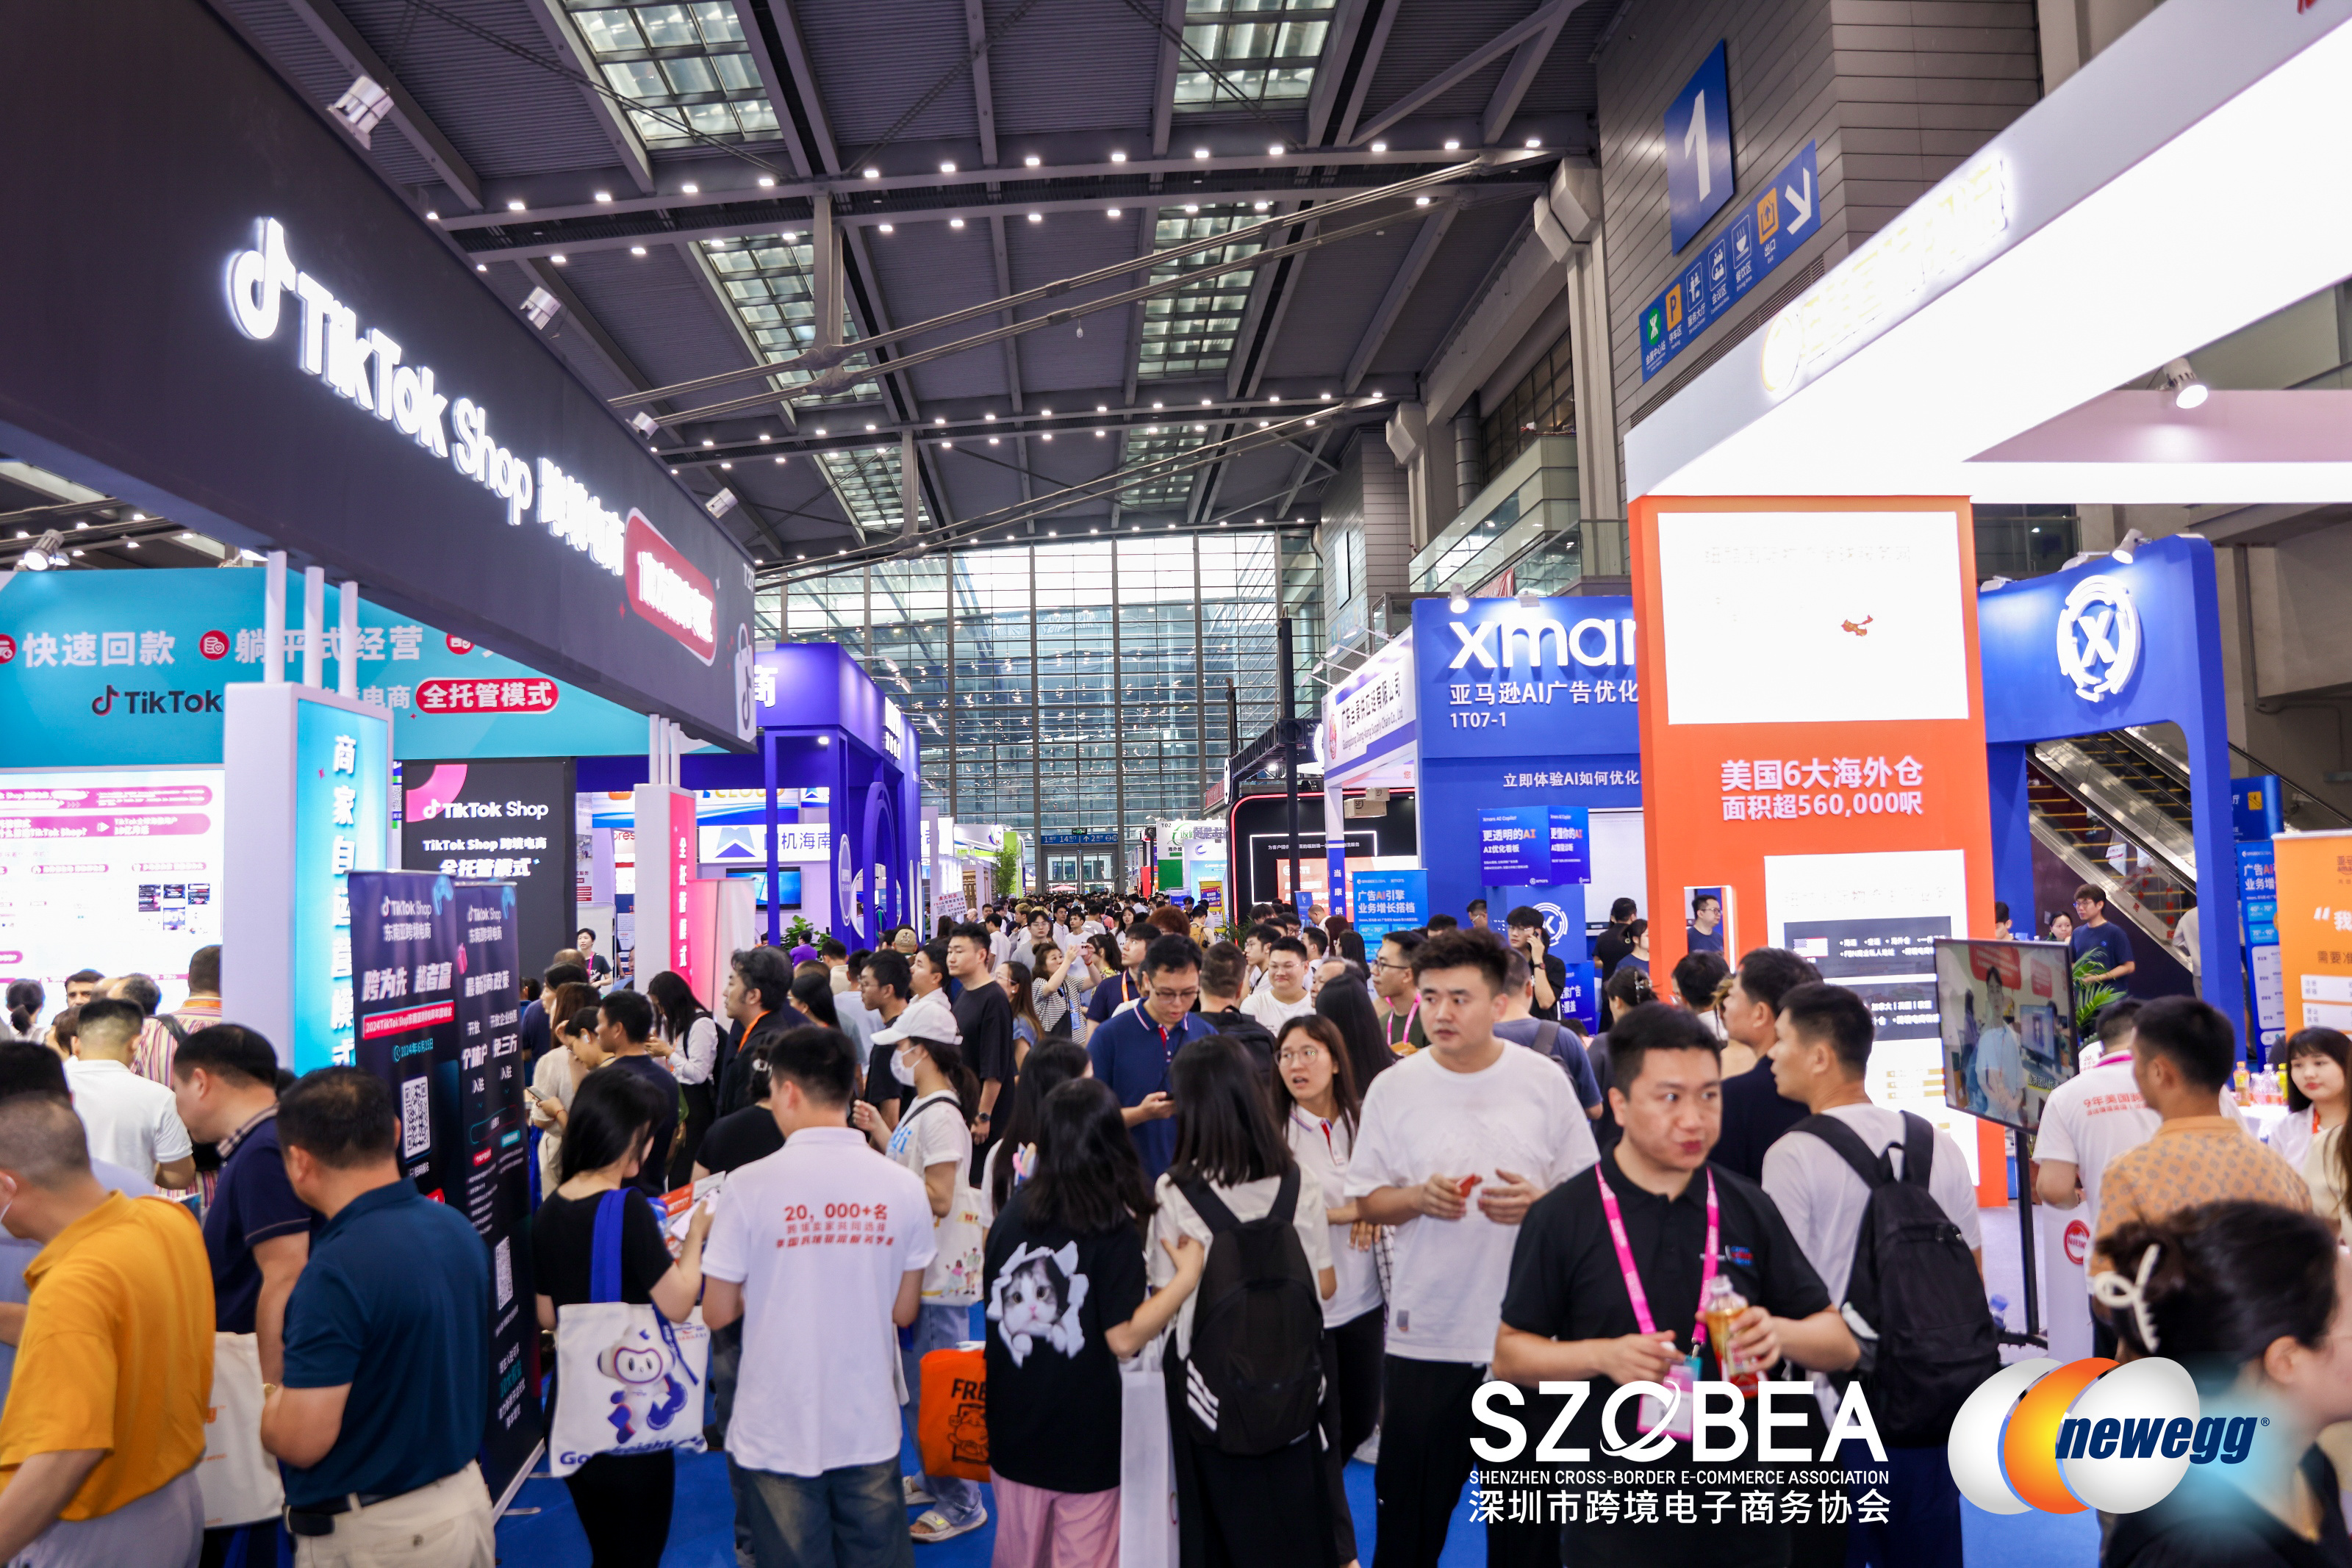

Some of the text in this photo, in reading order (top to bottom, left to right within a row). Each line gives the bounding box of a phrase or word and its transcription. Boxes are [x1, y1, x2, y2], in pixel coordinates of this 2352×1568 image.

[1684, 88, 1711, 203] 1
[1764, 239, 1776, 257] 出口
[1735, 260, 1752, 283] 餐饮区
[1712, 284, 1727, 305] 会议区
[1687, 303, 1706, 328] 服务大厅
[1668, 325, 1682, 345] 停车区
[1645, 340, 1666, 366] 会展中心站
[296, 270, 448, 458] TikTok
[453, 396, 533, 525] Shop
[24, 630, 176, 668] 快速回款
[124, 689, 223, 715] TikTok
[422, 681, 553, 709] 全托管模式
[1449, 680, 1639, 705] 亚马逊AI广告优化
[1450, 711, 1507, 728] 1T07-1
[1502, 769, 1640, 788] 立即体验AI如何优化
[1720, 755, 1923, 793] 美国6大海外仓
[442, 800, 549, 821] TikTok Shop
[1721, 791, 1923, 821] 面积超560,000呎
[1482, 828, 1537, 842] 更透明的AI
[1549, 827, 1583, 840] 更懂你的AI
[422, 837, 547, 852] TikTok Shop 跨境电商
[1482, 844, 1520, 854] AI优化看板
[440, 857, 532, 877] 全托管模式
[1358, 889, 1405, 902] 广告AI引擎
[390, 899, 432, 918] TikTok Shop
[489, 906, 502, 923] Shop
[1358, 902, 1416, 914] 业务增长搭档
[383, 922, 432, 943] 东南亚跨境电商
[361, 961, 453, 1003] 跨为先 越者赢
[1561, 999, 1577, 1014] 覆盖
[467, 1021, 481, 1037] 开放
[492, 1033, 518, 1059] 免三方
[501, 1065, 512, 1080] 入驻
[472, 1077, 484, 1094] 入驻
